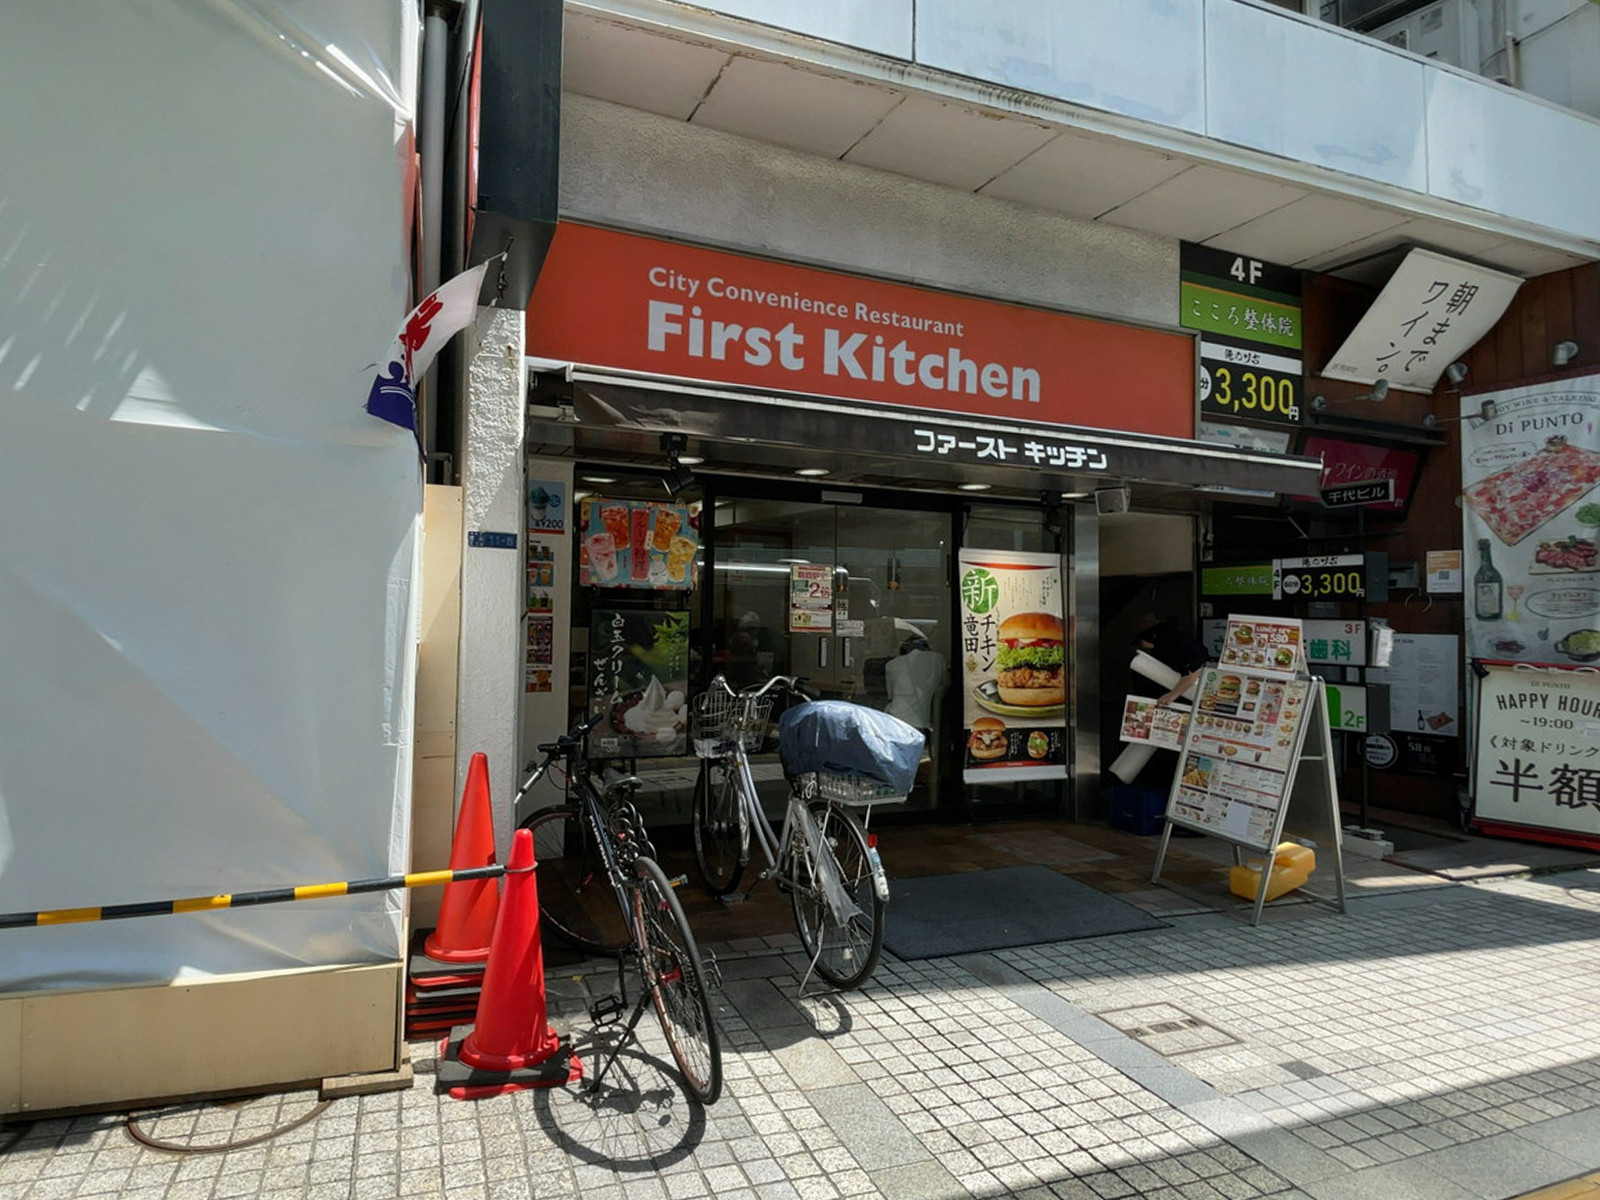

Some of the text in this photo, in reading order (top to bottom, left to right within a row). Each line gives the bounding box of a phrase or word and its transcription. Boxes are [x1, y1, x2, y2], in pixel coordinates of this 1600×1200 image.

[1231, 257, 1263, 285] 4F
[648, 266, 965, 337] City Convenience Restaurant
[1192, 299, 1294, 337] こころ整体院
[1405, 281, 1480, 372] 朝まで
[647, 299, 1041, 403] First Kitchen
[1495, 421, 1513, 436] Di
[1521, 412, 1584, 433] PUNTO
[914, 428, 1108, 470] ファースト キッチン
[1328, 486, 1385, 503] 千代ビル
[962, 569, 998, 611] 新
[963, 613, 980, 654] 竜田
[979, 614, 997, 673] チキン
[1345, 623, 1362, 634] 3F
[610, 613, 626, 705] 白玉クリーム
[1303, 638, 1352, 662] 歯科
[1344, 710, 1365, 728] 2F
[1496, 692, 1549, 710] HAPPY
[1489, 757, 1600, 813] 半額
